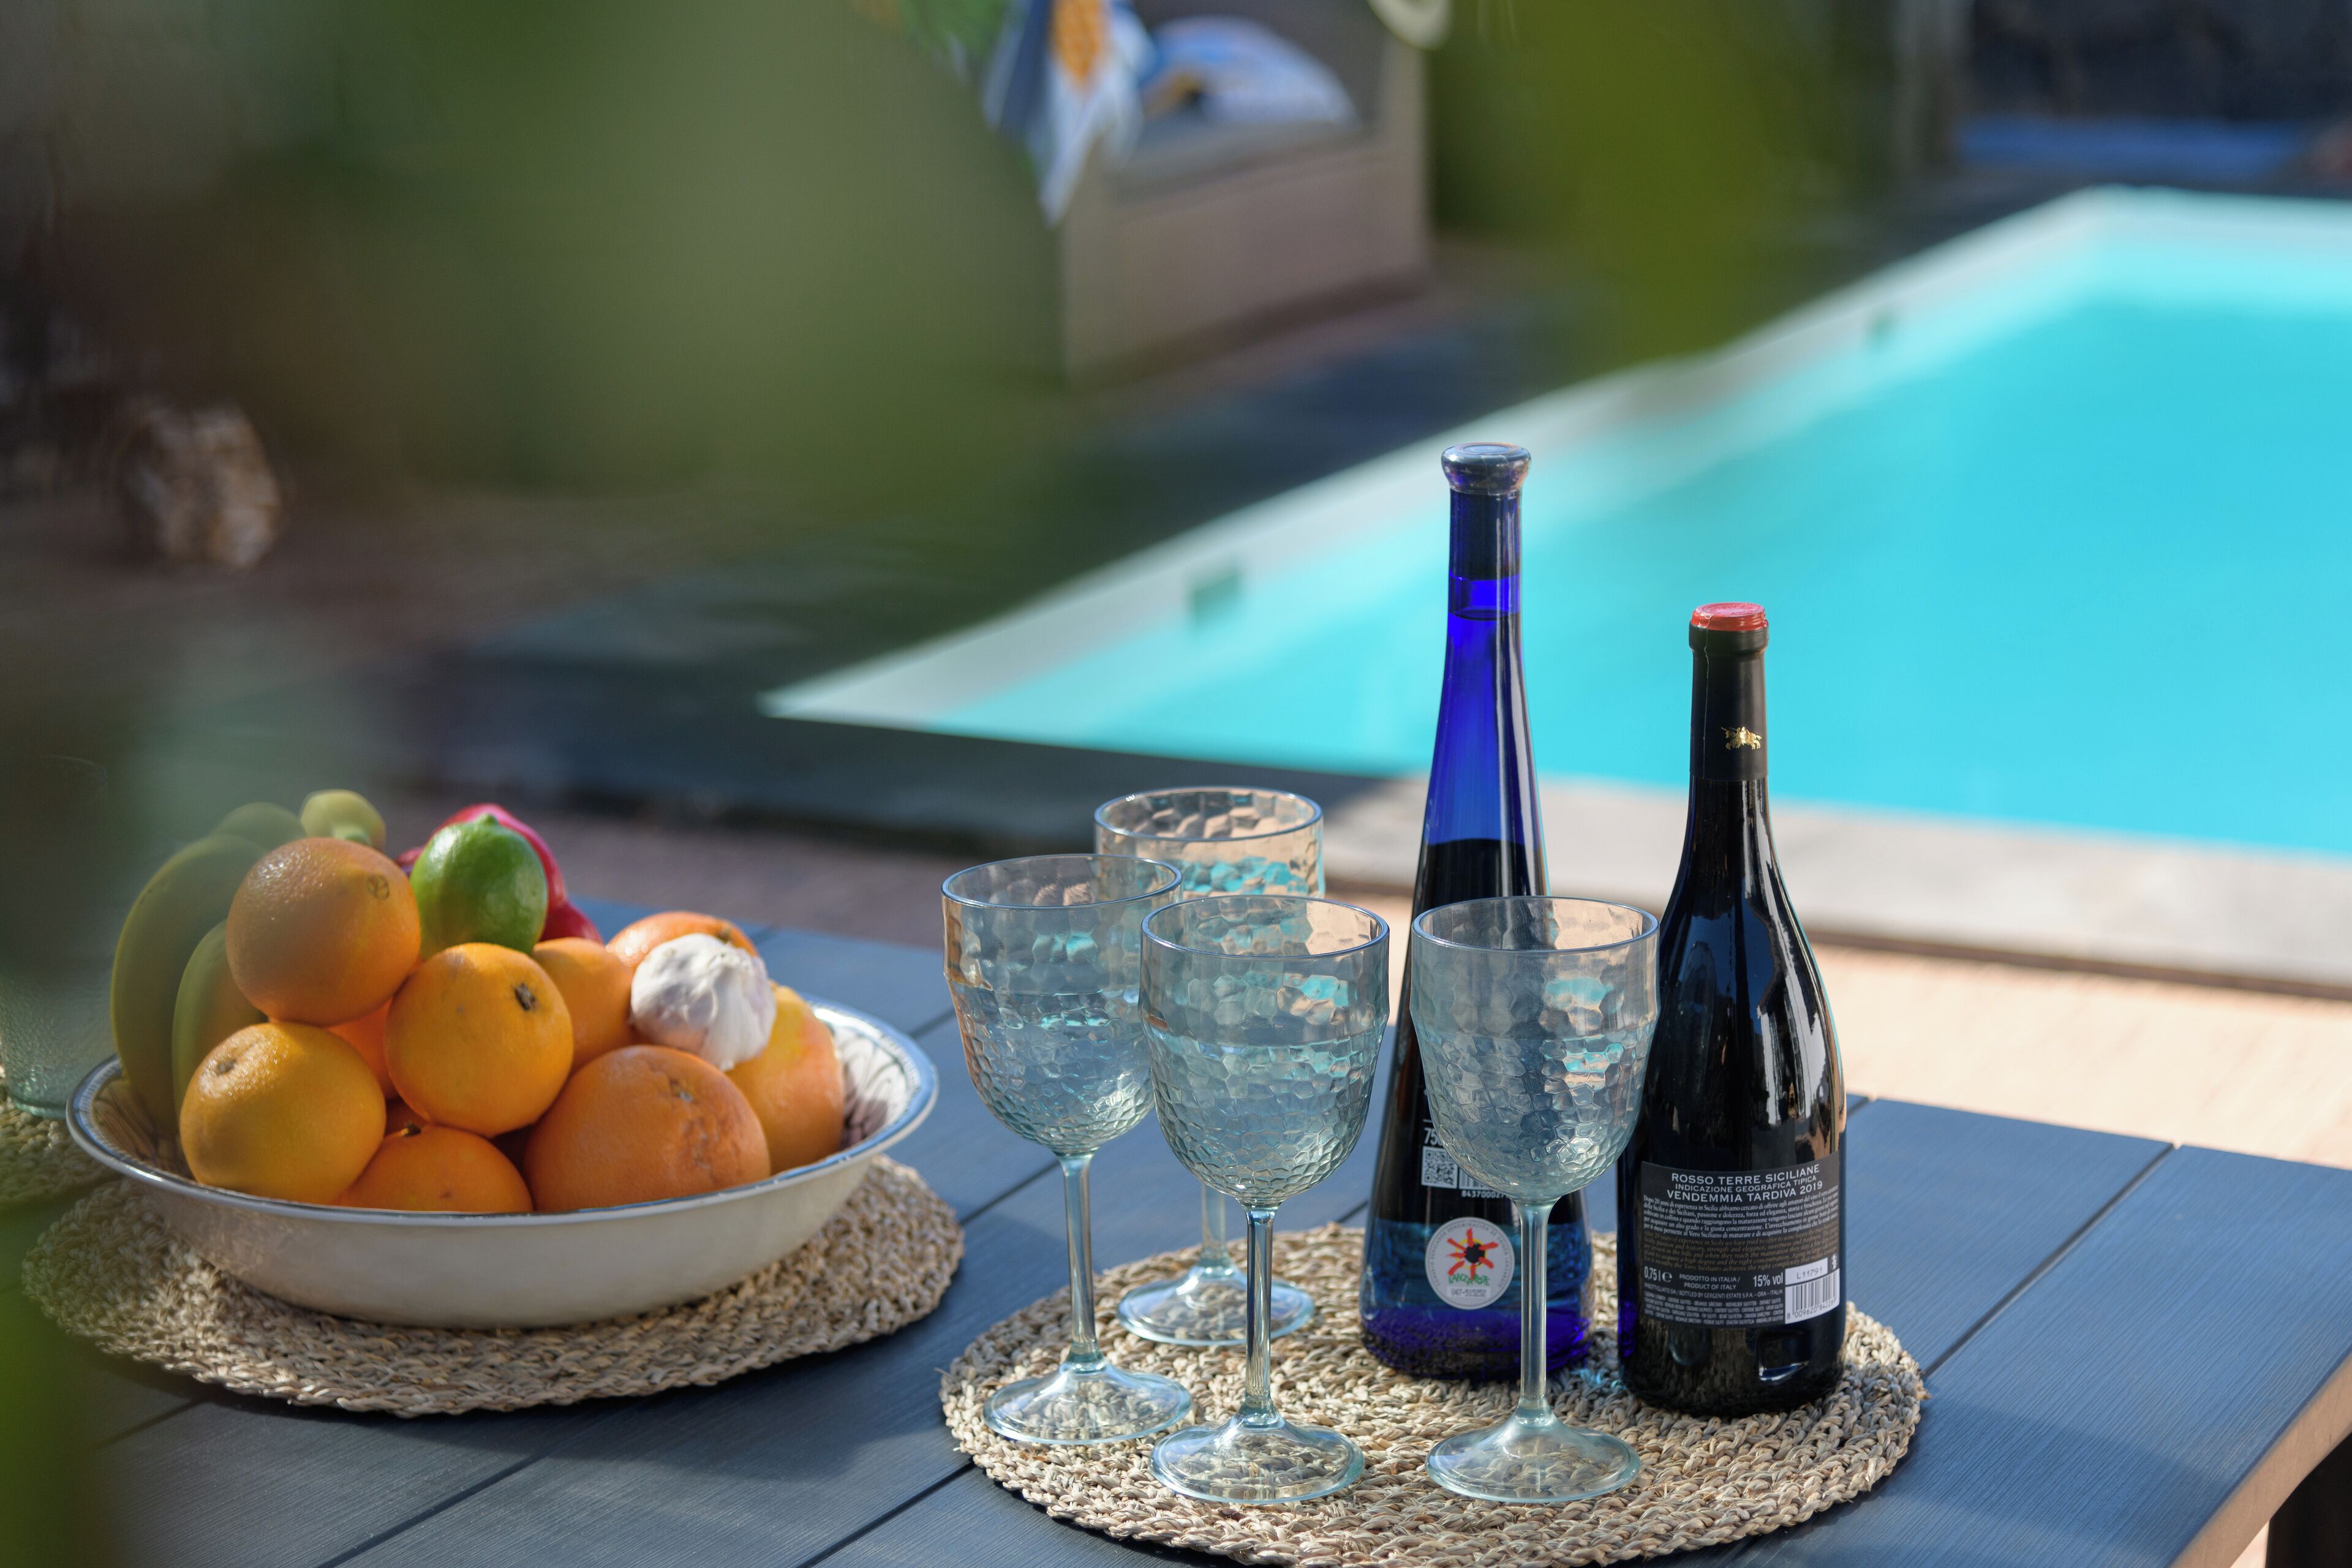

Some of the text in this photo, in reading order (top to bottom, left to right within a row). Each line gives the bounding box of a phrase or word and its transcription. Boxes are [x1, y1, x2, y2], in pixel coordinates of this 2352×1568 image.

[1424, 1127, 1441, 1145] 75
[1672, 1164, 1820, 1186] ROSSO TERRE SICILIANE
[1675, 1175, 1817, 1193] INDICAZIONE GEOGRAFICA TIPICA
[1461, 1189, 1506, 1199] 843700027
[1667, 1189, 1743, 1203] VENDEMMIA
[1747, 1188, 1796, 1202] TARDIVA
[1800, 1180, 1823, 1195] 2019
[1653, 1204, 1665, 1212] Sicilia
[1676, 1208, 1695, 1217] Siciliani,
[1766, 1206, 1787, 1217] eleganza,
[1675, 1202, 1697, 1212] esperienza
[1664, 1212, 1678, 1221] collina
[1683, 1215, 1700, 1225] quando
[1768, 1215, 1787, 1224] vengono
[1664, 1227, 1682, 1236] permette
[1762, 1229, 1782, 1238] acquisire
[1685, 1223, 1699, 1232] grado
[1679, 1273, 1709, 1282] PRODOTTO
[1752, 1271, 1784, 1287] 15% vol
[1796, 1265, 1822, 1280] L11791
[1447, 1273, 1490, 1286] LANZAROTE
[1683, 1281, 1710, 1290] PRODUCT
[1795, 1305, 1817, 1318] 009620
